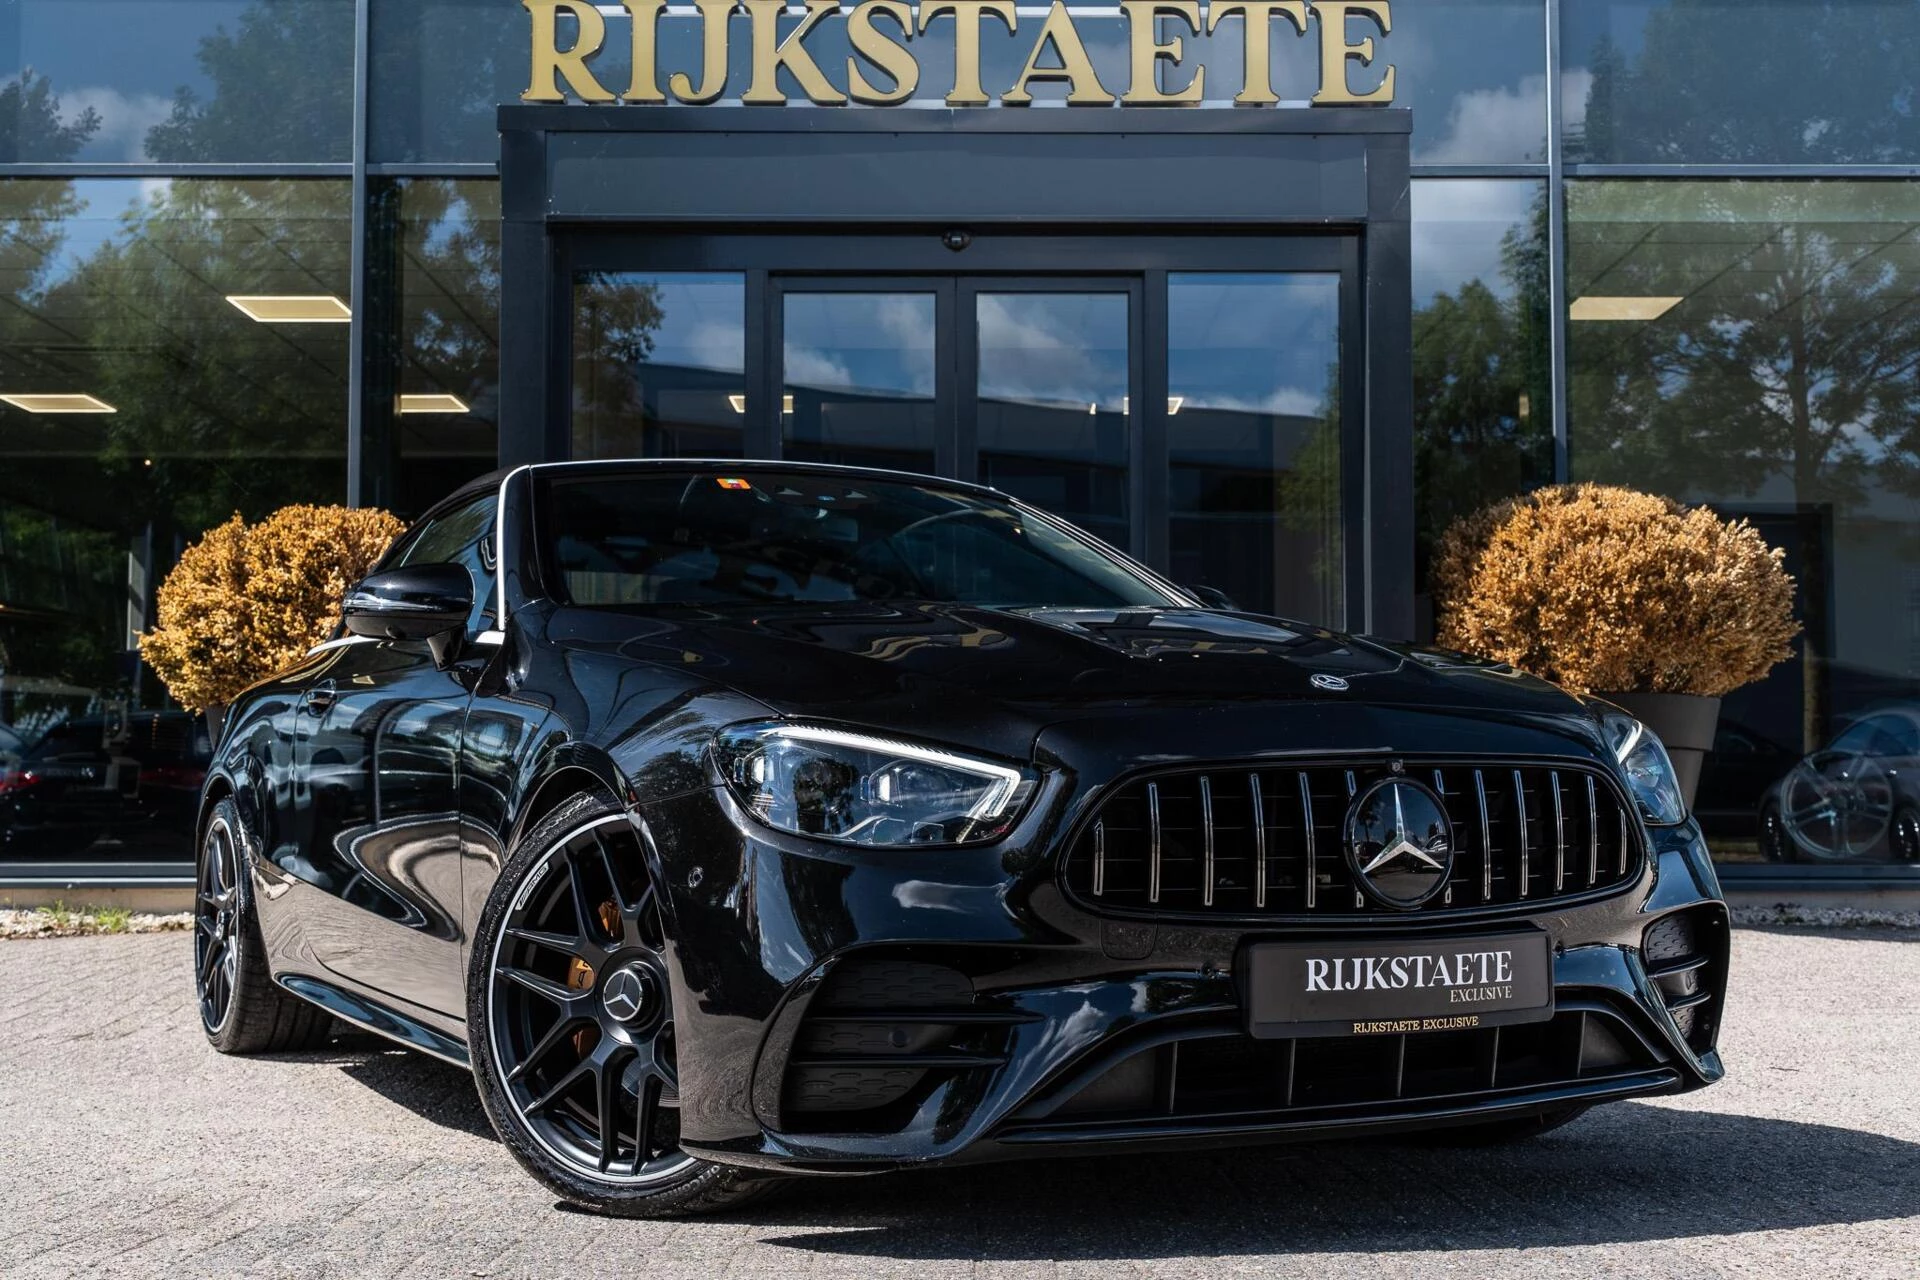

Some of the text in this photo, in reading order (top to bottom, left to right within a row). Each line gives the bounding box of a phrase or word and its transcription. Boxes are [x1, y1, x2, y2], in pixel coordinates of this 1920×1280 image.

[521, 0, 1395, 106] RIJKSTAETE
[1305, 950, 1513, 992] RIJKSTAETE
[1450, 985, 1512, 1003] EXCLUSIVE
[1353, 1016, 1479, 1034] RIJKSTAETE EXCLUSIVE
